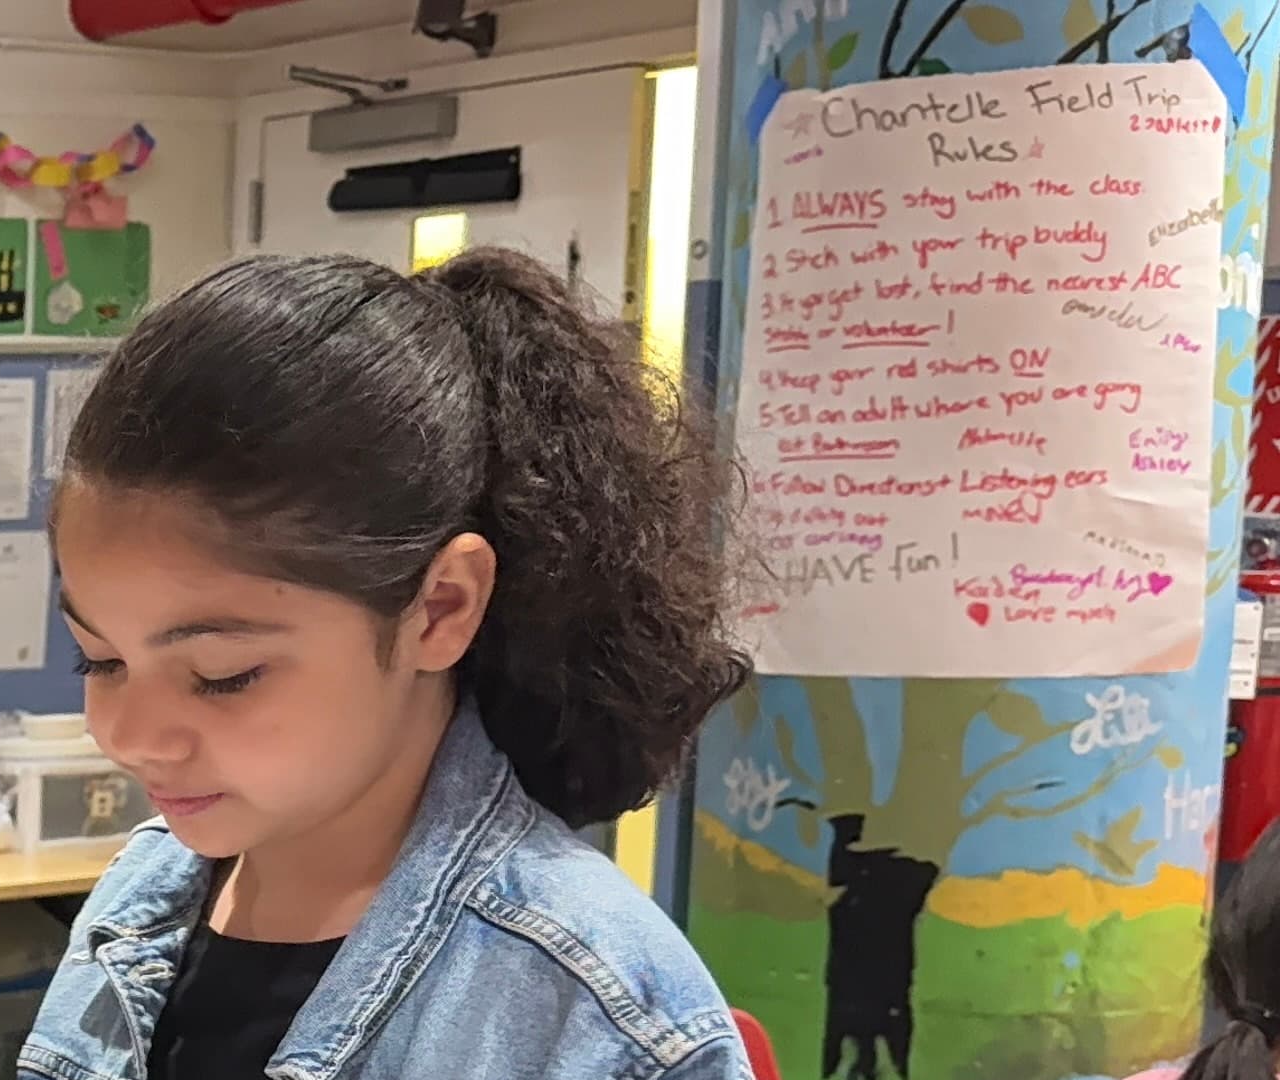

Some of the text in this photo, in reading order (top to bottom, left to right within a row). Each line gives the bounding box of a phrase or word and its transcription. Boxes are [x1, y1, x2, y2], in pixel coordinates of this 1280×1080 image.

[820, 75, 1181, 138] Chantelle Field Trip
[927, 132, 1018, 166] Rules
[791, 188, 888, 220] ALWAYS
[903, 186, 957, 220] stay
[966, 180, 1021, 201] with
[1029, 177, 1074, 197] the
[851, 240, 899, 264] with
[911, 237, 966, 269] your
[975, 227, 1027, 261] trip
[1033, 220, 1108, 263] buddy
[930, 271, 984, 297] find
[988, 271, 1035, 295] the
[1046, 270, 1128, 293] nearest
[1130, 261, 1182, 292] ABC
[886, 356, 918, 379] red
[926, 354, 1000, 377] shirts
[1009, 346, 1050, 370] ON
[776, 403, 811, 426] Tell
[816, 407, 846, 424] an
[852, 395, 909, 422] adult
[999, 388, 1044, 417] you
[1052, 384, 1089, 399] are
[1092, 381, 1142, 414] going
[780, 552, 876, 597] HAVE
